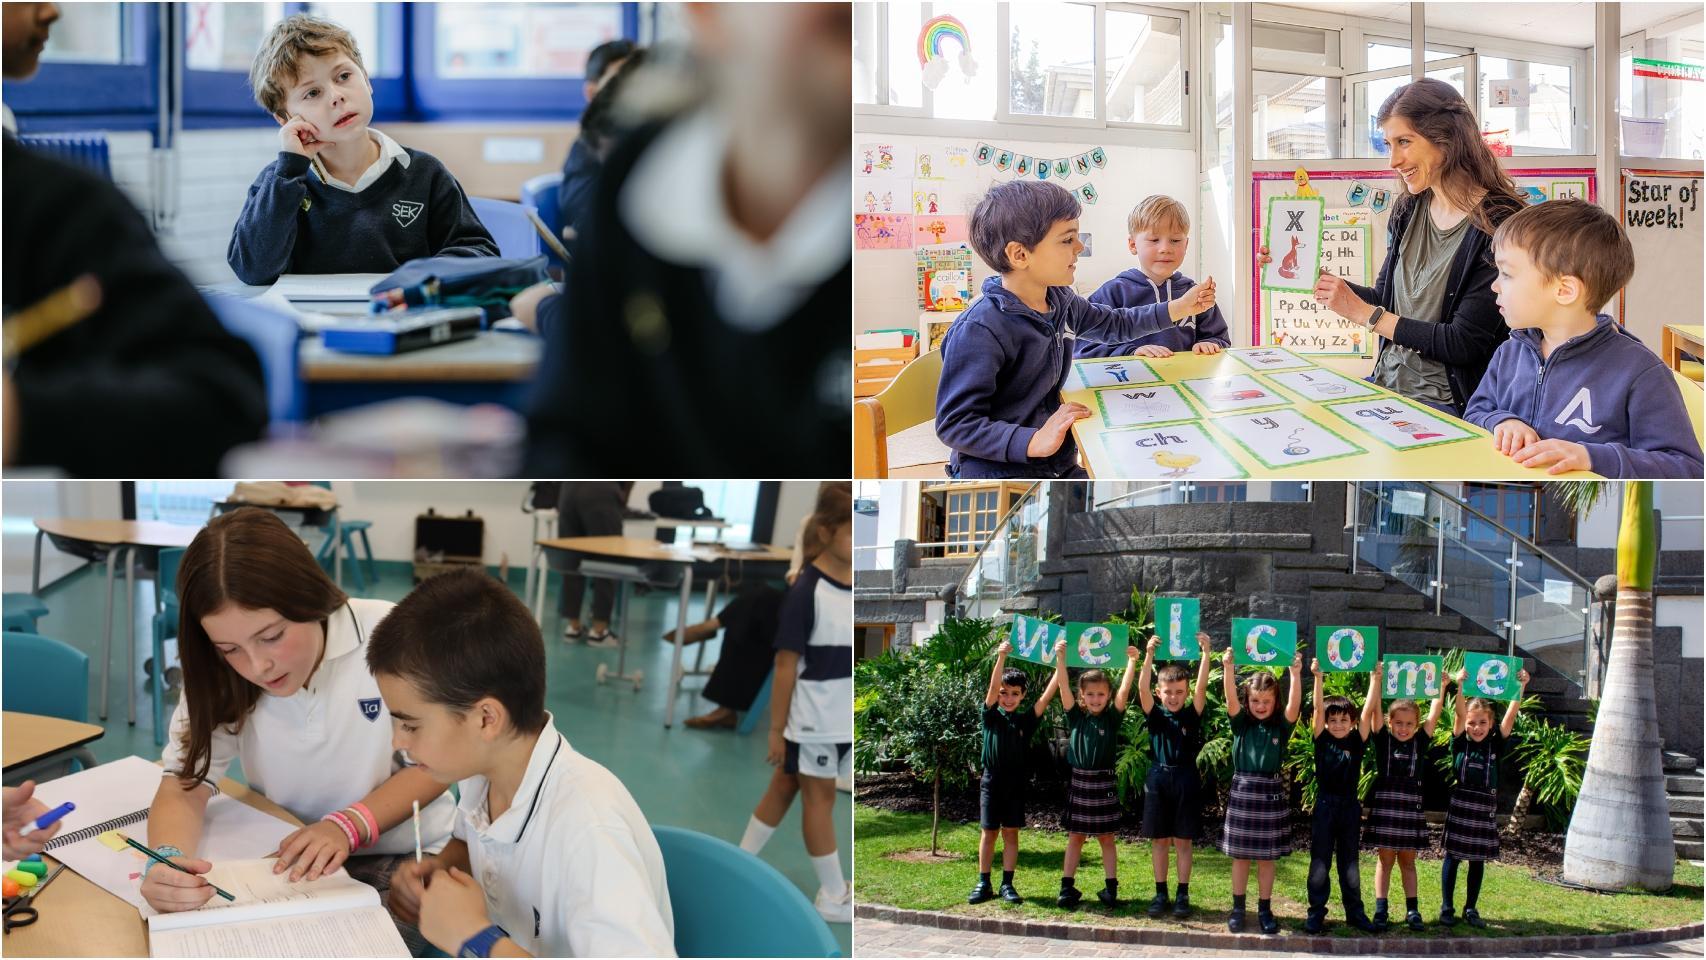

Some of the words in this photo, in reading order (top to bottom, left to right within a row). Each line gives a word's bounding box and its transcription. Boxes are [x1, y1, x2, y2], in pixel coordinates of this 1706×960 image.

[978, 147, 1102, 174] READING
[1628, 180, 1672, 204] Star
[1679, 179, 1699, 211] of
[391, 203, 418, 218] SEK
[1628, 204, 1684, 229] week!
[1340, 230, 1358, 241] Dd
[1337, 247, 1354, 258] Hh
[1280, 299, 1294, 313] Pp
[1300, 299, 1318, 314] Qq
[1274, 318, 1287, 328] Tt
[1293, 318, 1310, 328] Uu
[1315, 318, 1332, 328] Vv
[1289, 335, 1306, 346] Xx
[1311, 335, 1326, 350] Yy
[1332, 335, 1348, 346] Zz
[1135, 432, 1188, 448] ch
